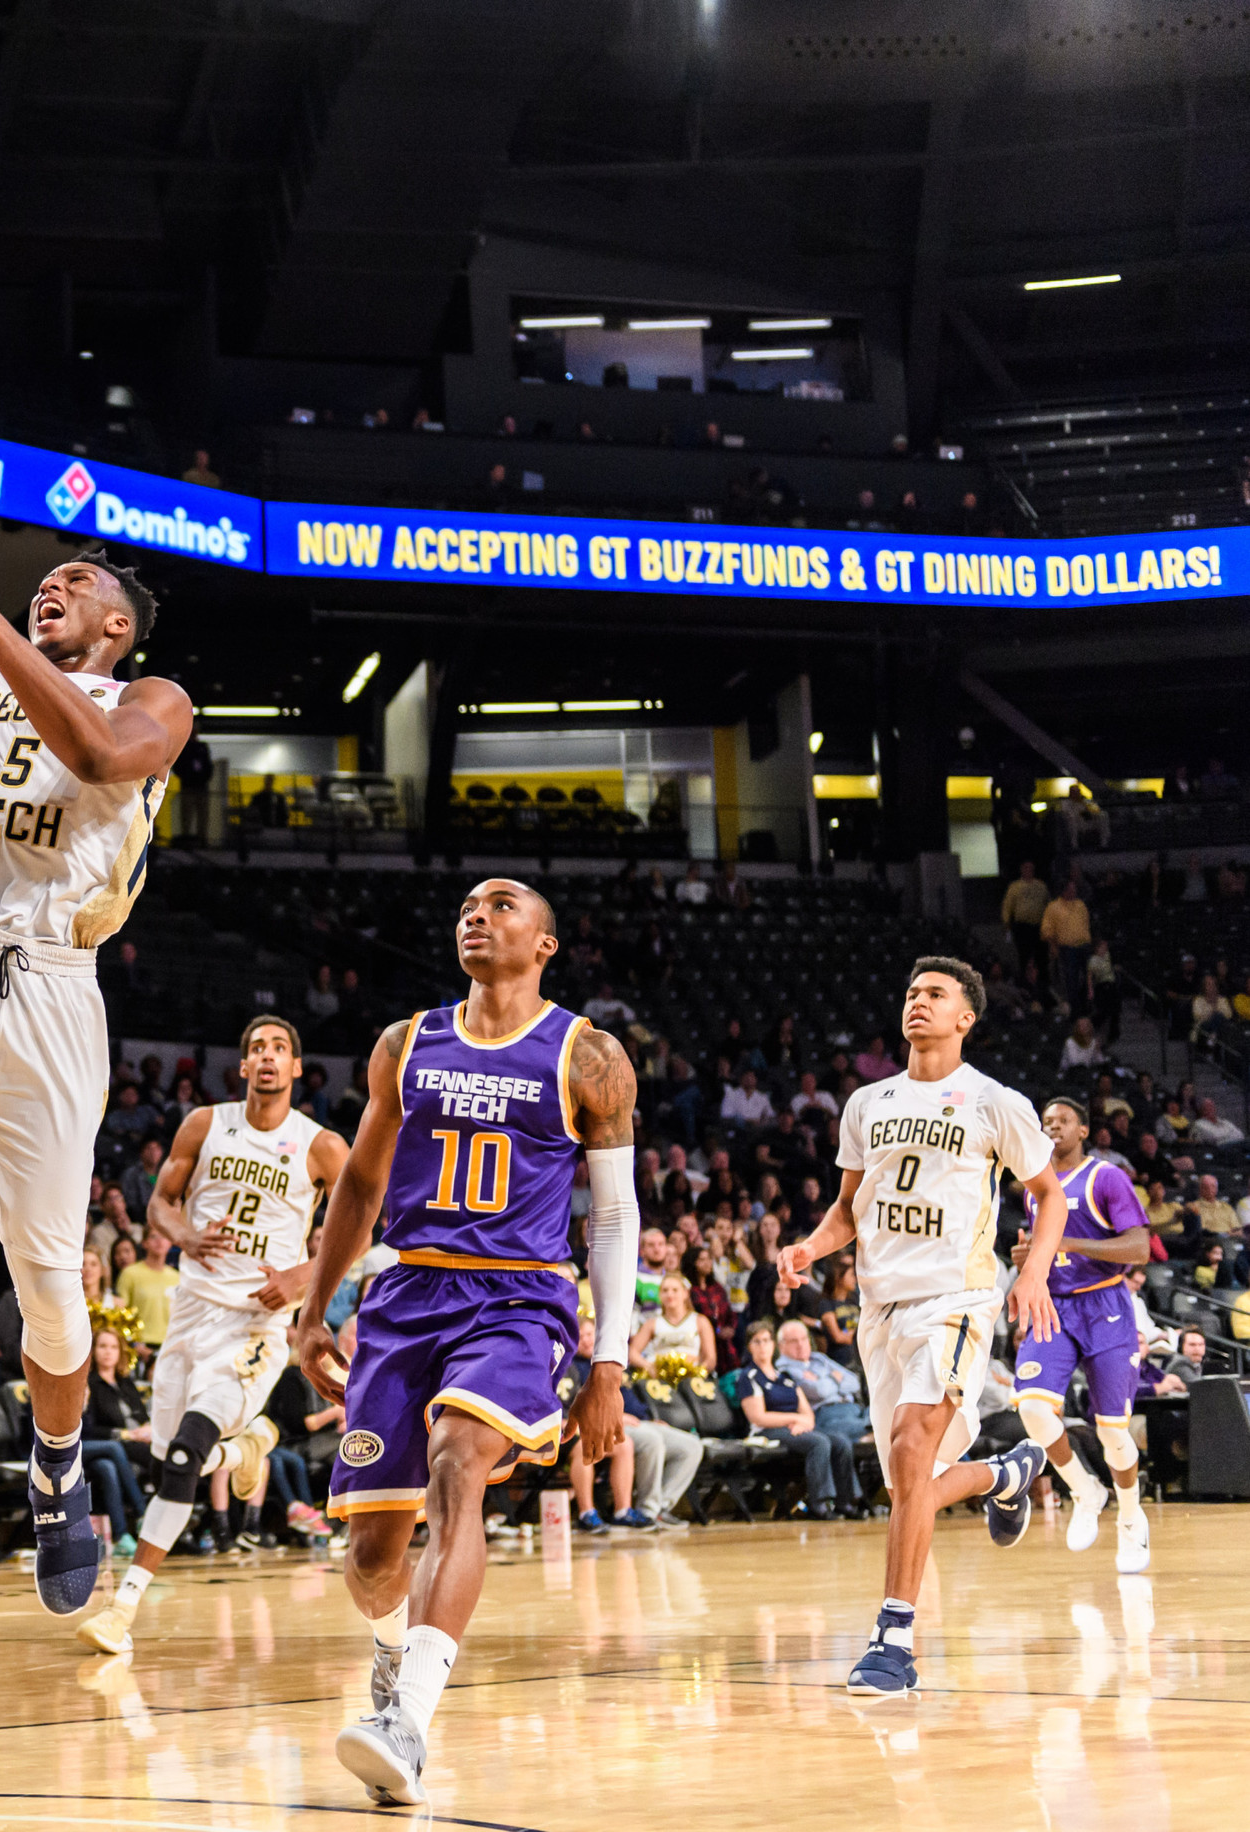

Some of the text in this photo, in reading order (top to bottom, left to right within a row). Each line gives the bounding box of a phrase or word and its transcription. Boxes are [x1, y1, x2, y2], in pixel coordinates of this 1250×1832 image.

[95, 491, 249, 563] Domino's
[297, 520, 1223, 598] NOW ACCEPTING GT BUZZFUNDS & GT DINING DOLLARS!
[0, 735, 42, 788] 5
[416, 1068, 543, 1104] TENNESSEE
[440, 1091, 508, 1123] TECH
[870, 1117, 965, 1157] GEORGIA
[209, 1155, 290, 1197] GEORGIA
[426, 1129, 512, 1214] 10
[227, 1190, 262, 1226] 12
[876, 1200, 945, 1238] TECH
